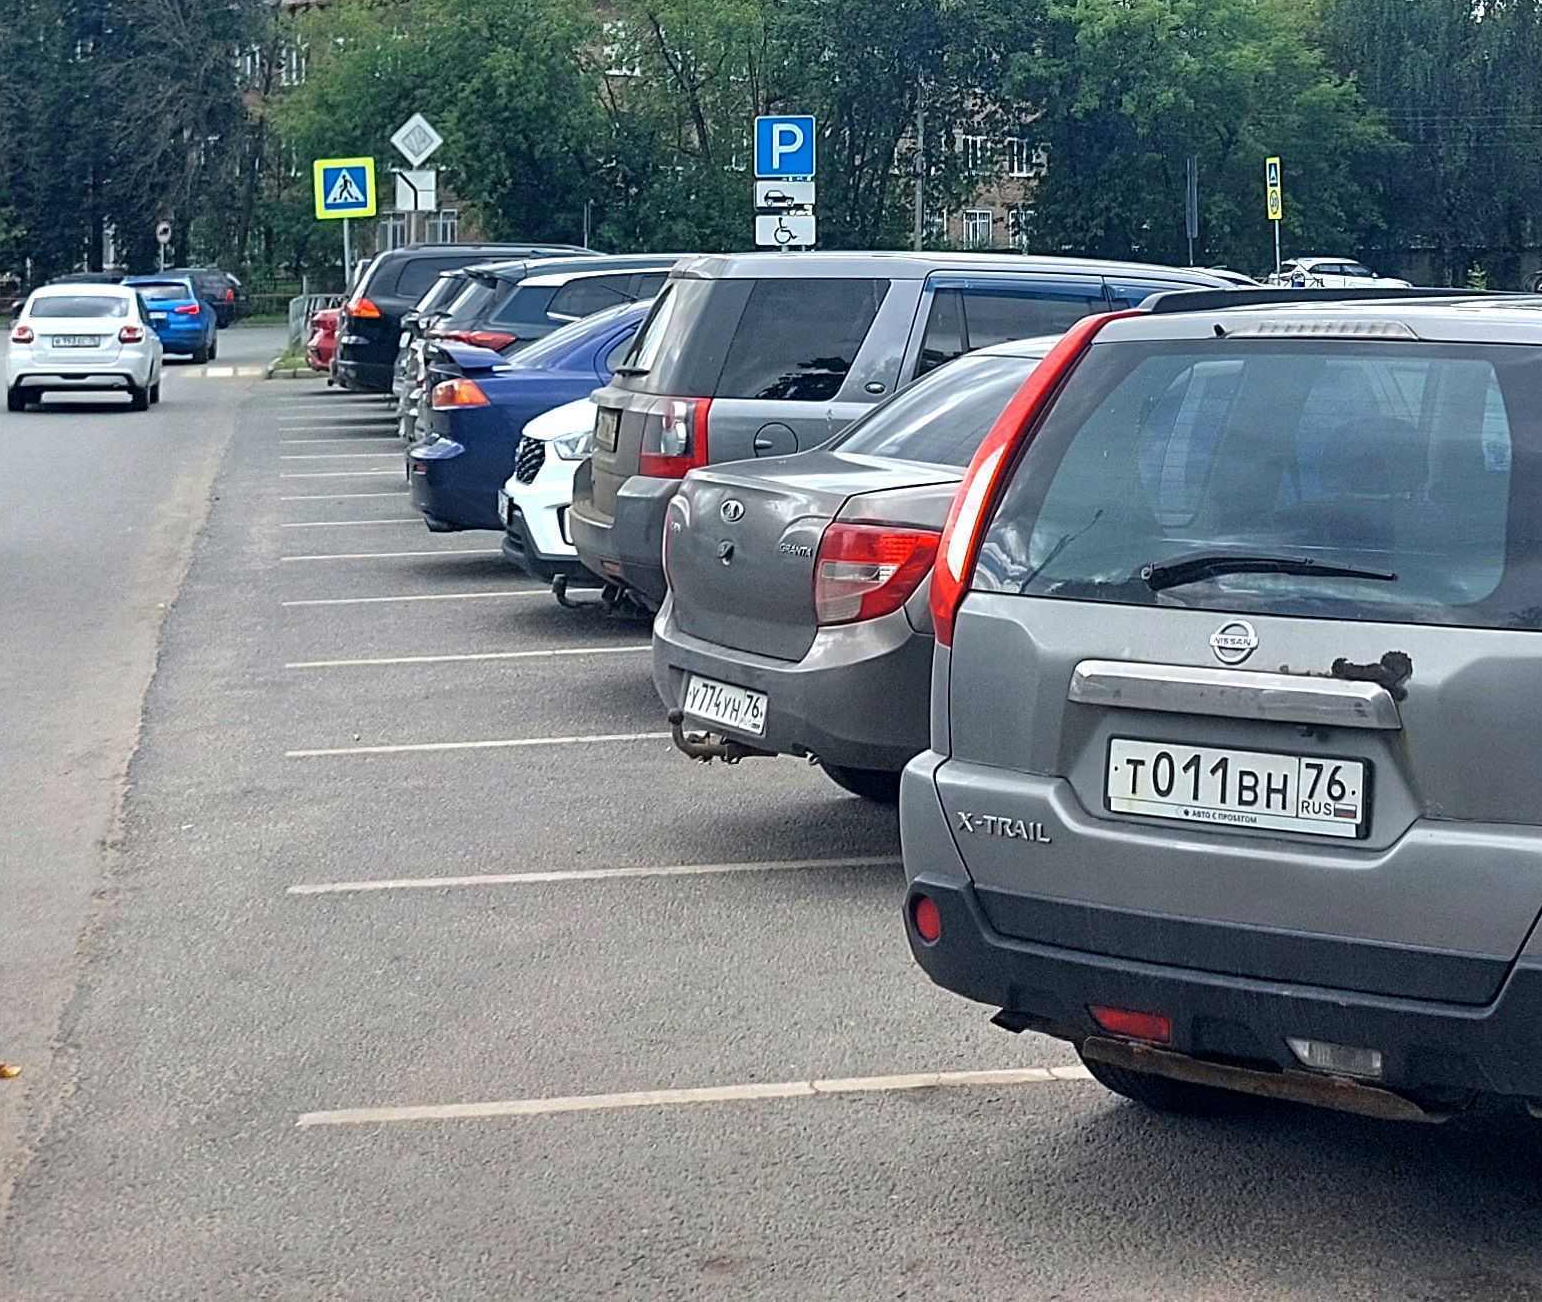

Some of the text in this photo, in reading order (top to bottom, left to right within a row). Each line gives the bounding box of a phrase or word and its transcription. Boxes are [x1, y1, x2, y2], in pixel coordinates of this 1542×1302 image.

[772, 123, 804, 170] P
[1214, 635, 1252, 647] NISSAN
[744, 694, 761, 719] 76
[1126, 751, 1347, 810] Т011ВН 76
[1301, 800, 1333, 816] RUS
[957, 811, 1053, 844] X-TRAIL
